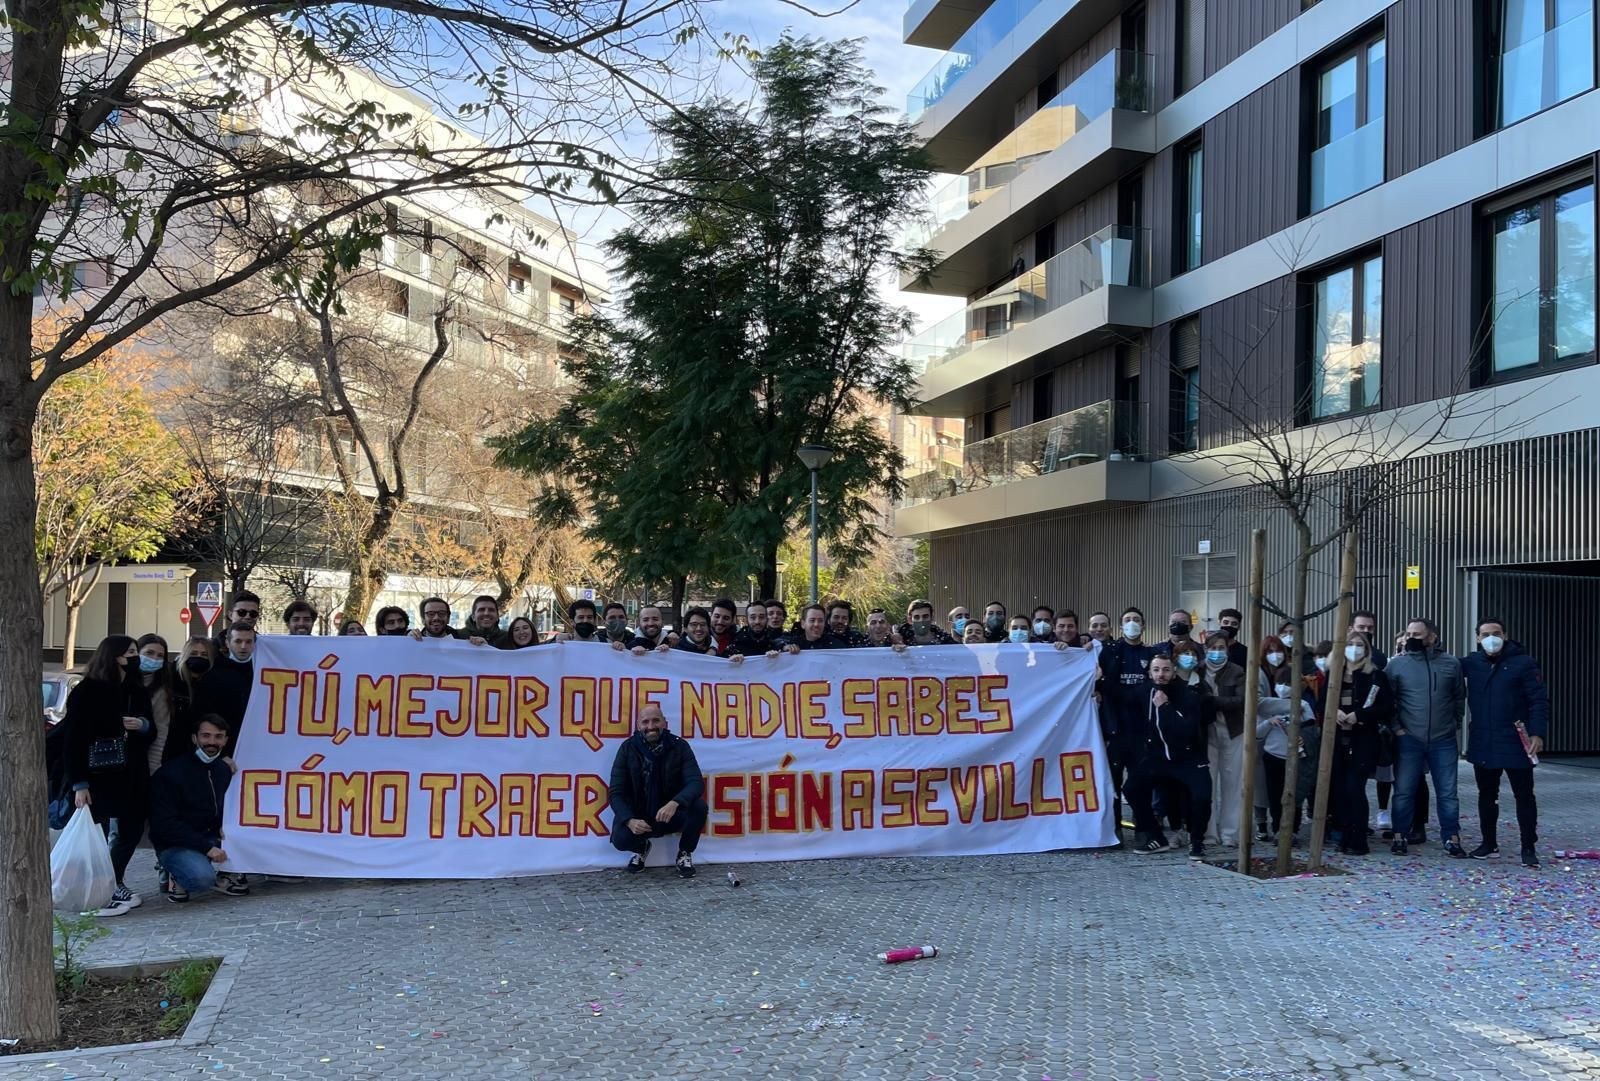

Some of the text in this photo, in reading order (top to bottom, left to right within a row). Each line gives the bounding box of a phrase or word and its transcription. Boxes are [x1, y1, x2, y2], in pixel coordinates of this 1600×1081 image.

[260, 653, 351, 745] TÚ,
[354, 674, 549, 738] MEJOR
[680, 680, 842, 749] NADIE,
[842, 674, 1014, 738] SABES
[239, 753, 409, 838] CÓMO
[420, 772, 611, 839] TRAER
[841, 769, 875, 831] A
[881, 751, 1099, 828] SEVILLA
